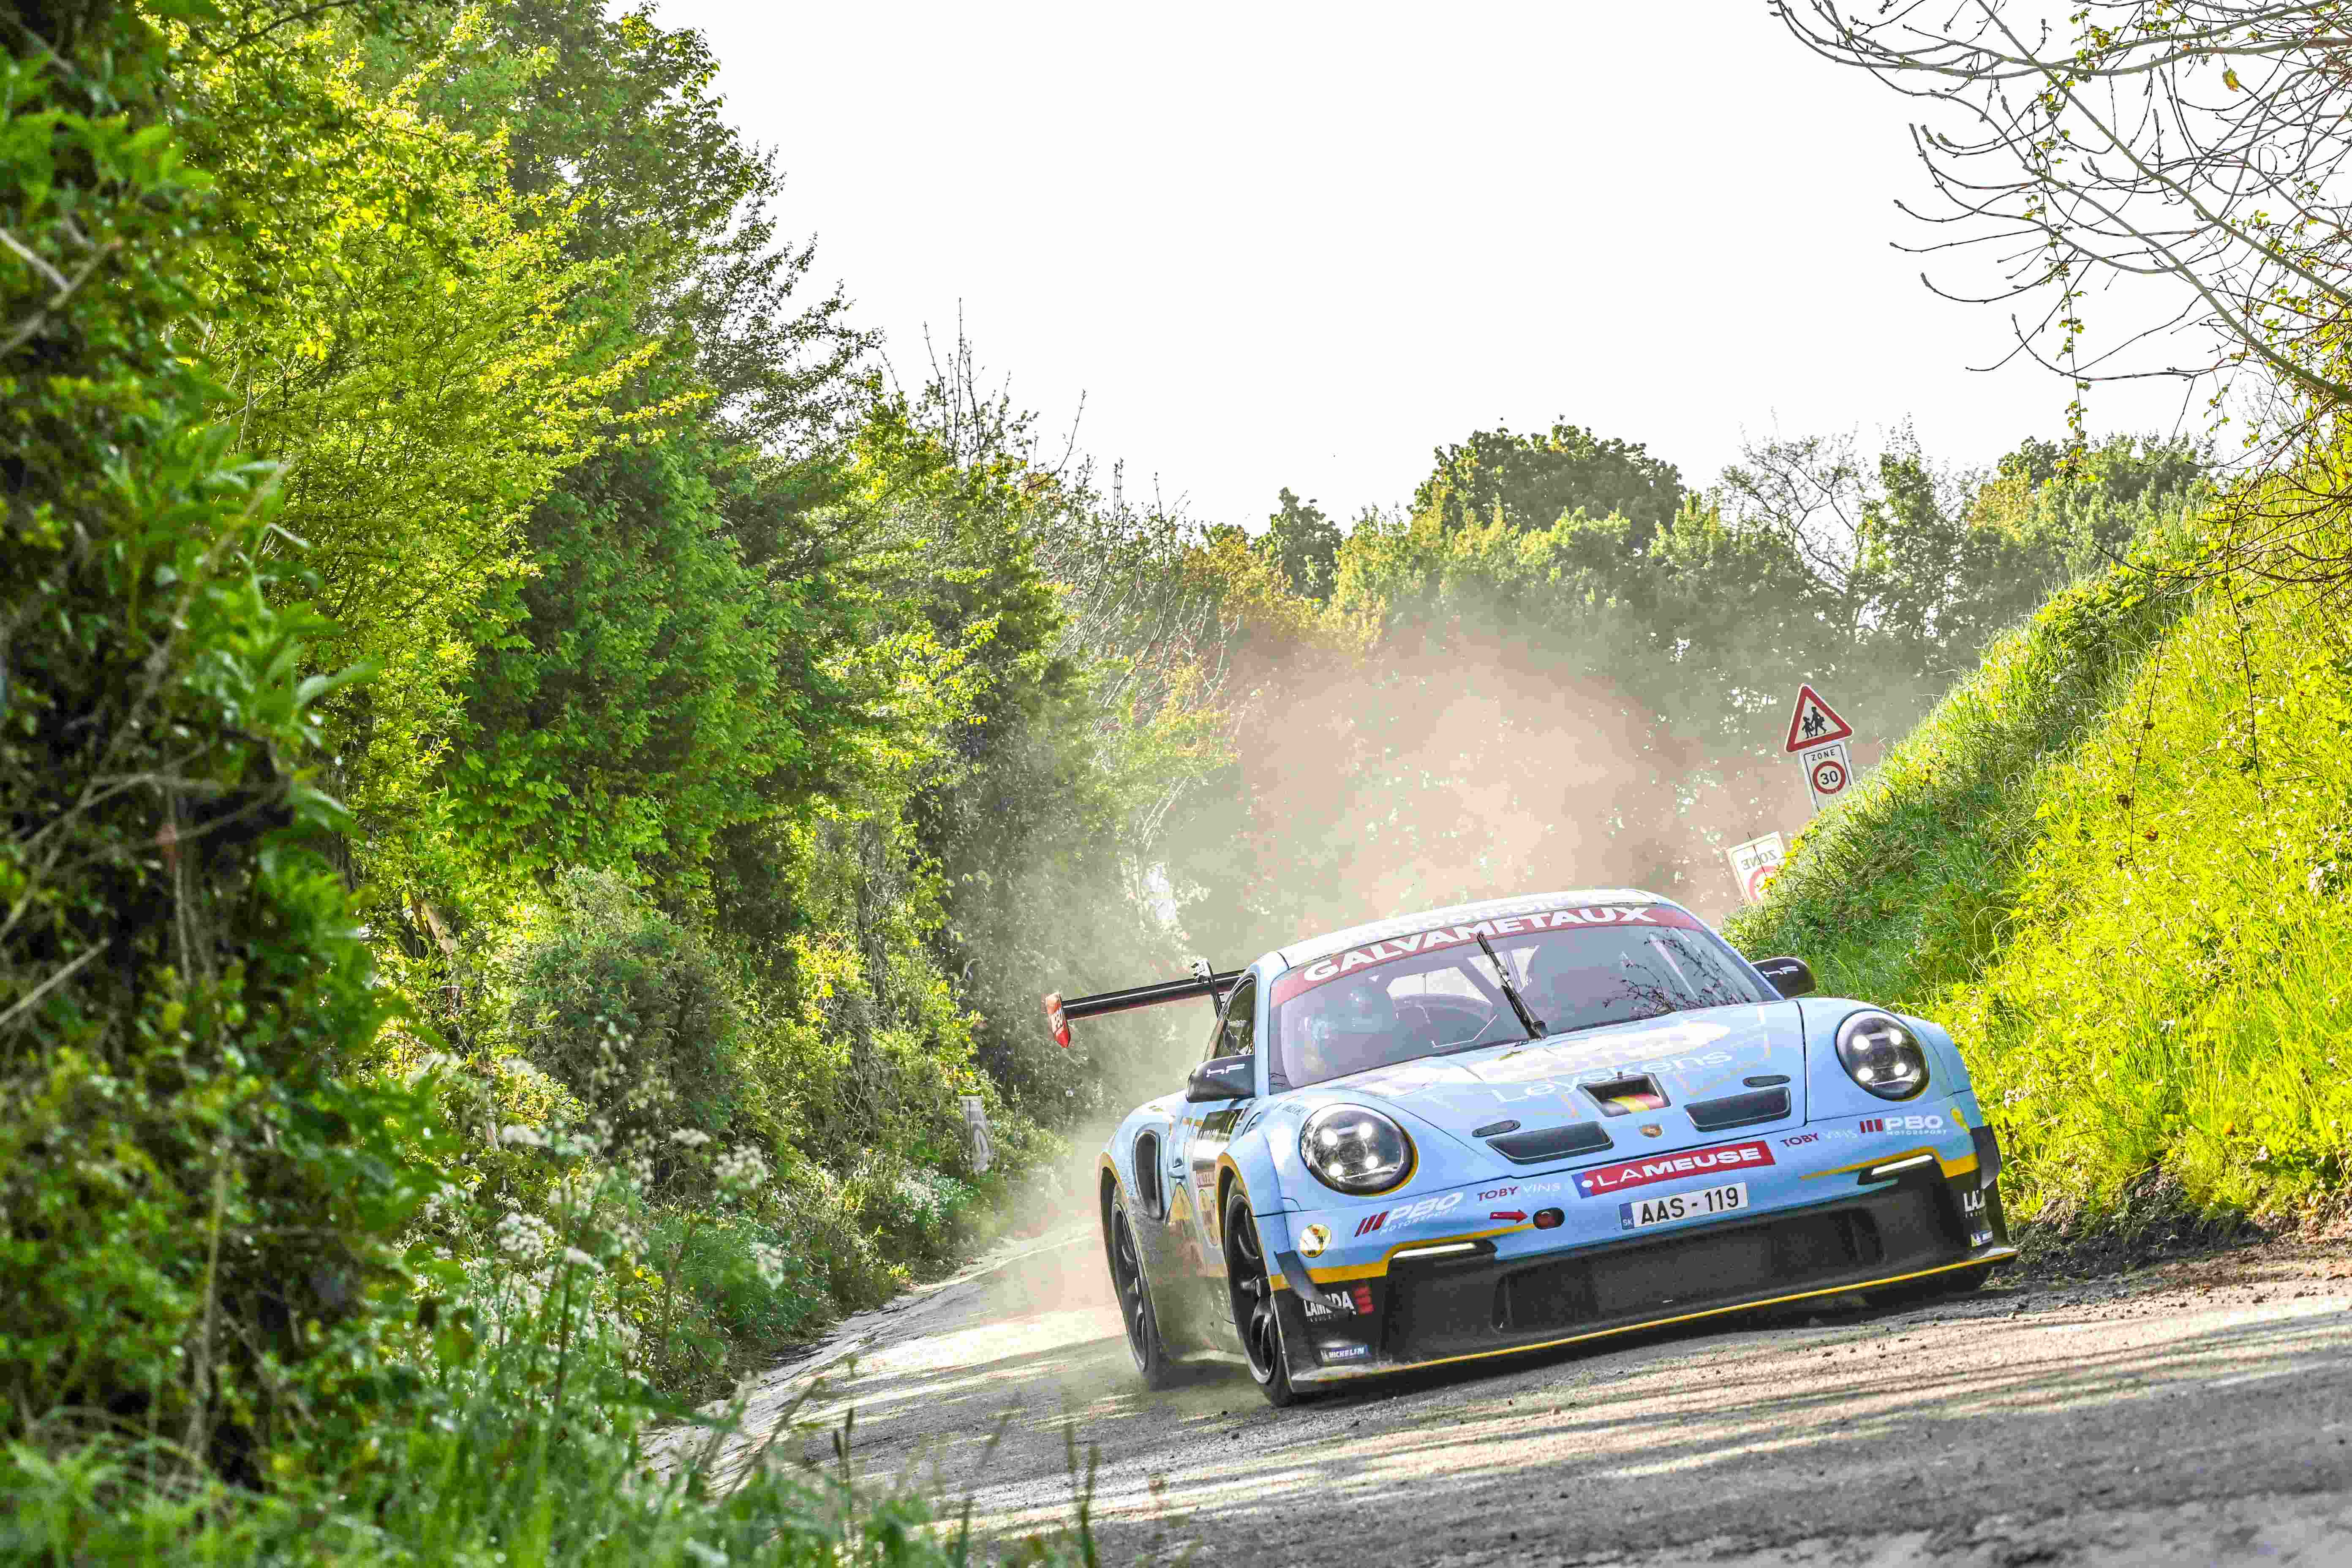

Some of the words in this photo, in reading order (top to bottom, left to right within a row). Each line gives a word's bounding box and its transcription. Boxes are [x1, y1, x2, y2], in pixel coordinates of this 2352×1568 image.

[1811, 749, 1835, 761] ZONE
[1820, 770, 1838, 784] 30
[1304, 906, 1658, 982] GALVAMETAUX
[1885, 1115, 1943, 1130] PBO
[1780, 1132, 1819, 1146] TOBY
[1477, 1186, 1518, 1201] TOBY
[1523, 1182, 1560, 1193] VINS
[1385, 1192, 1463, 1226] PBO
[1622, 1217, 1633, 1226] SK
